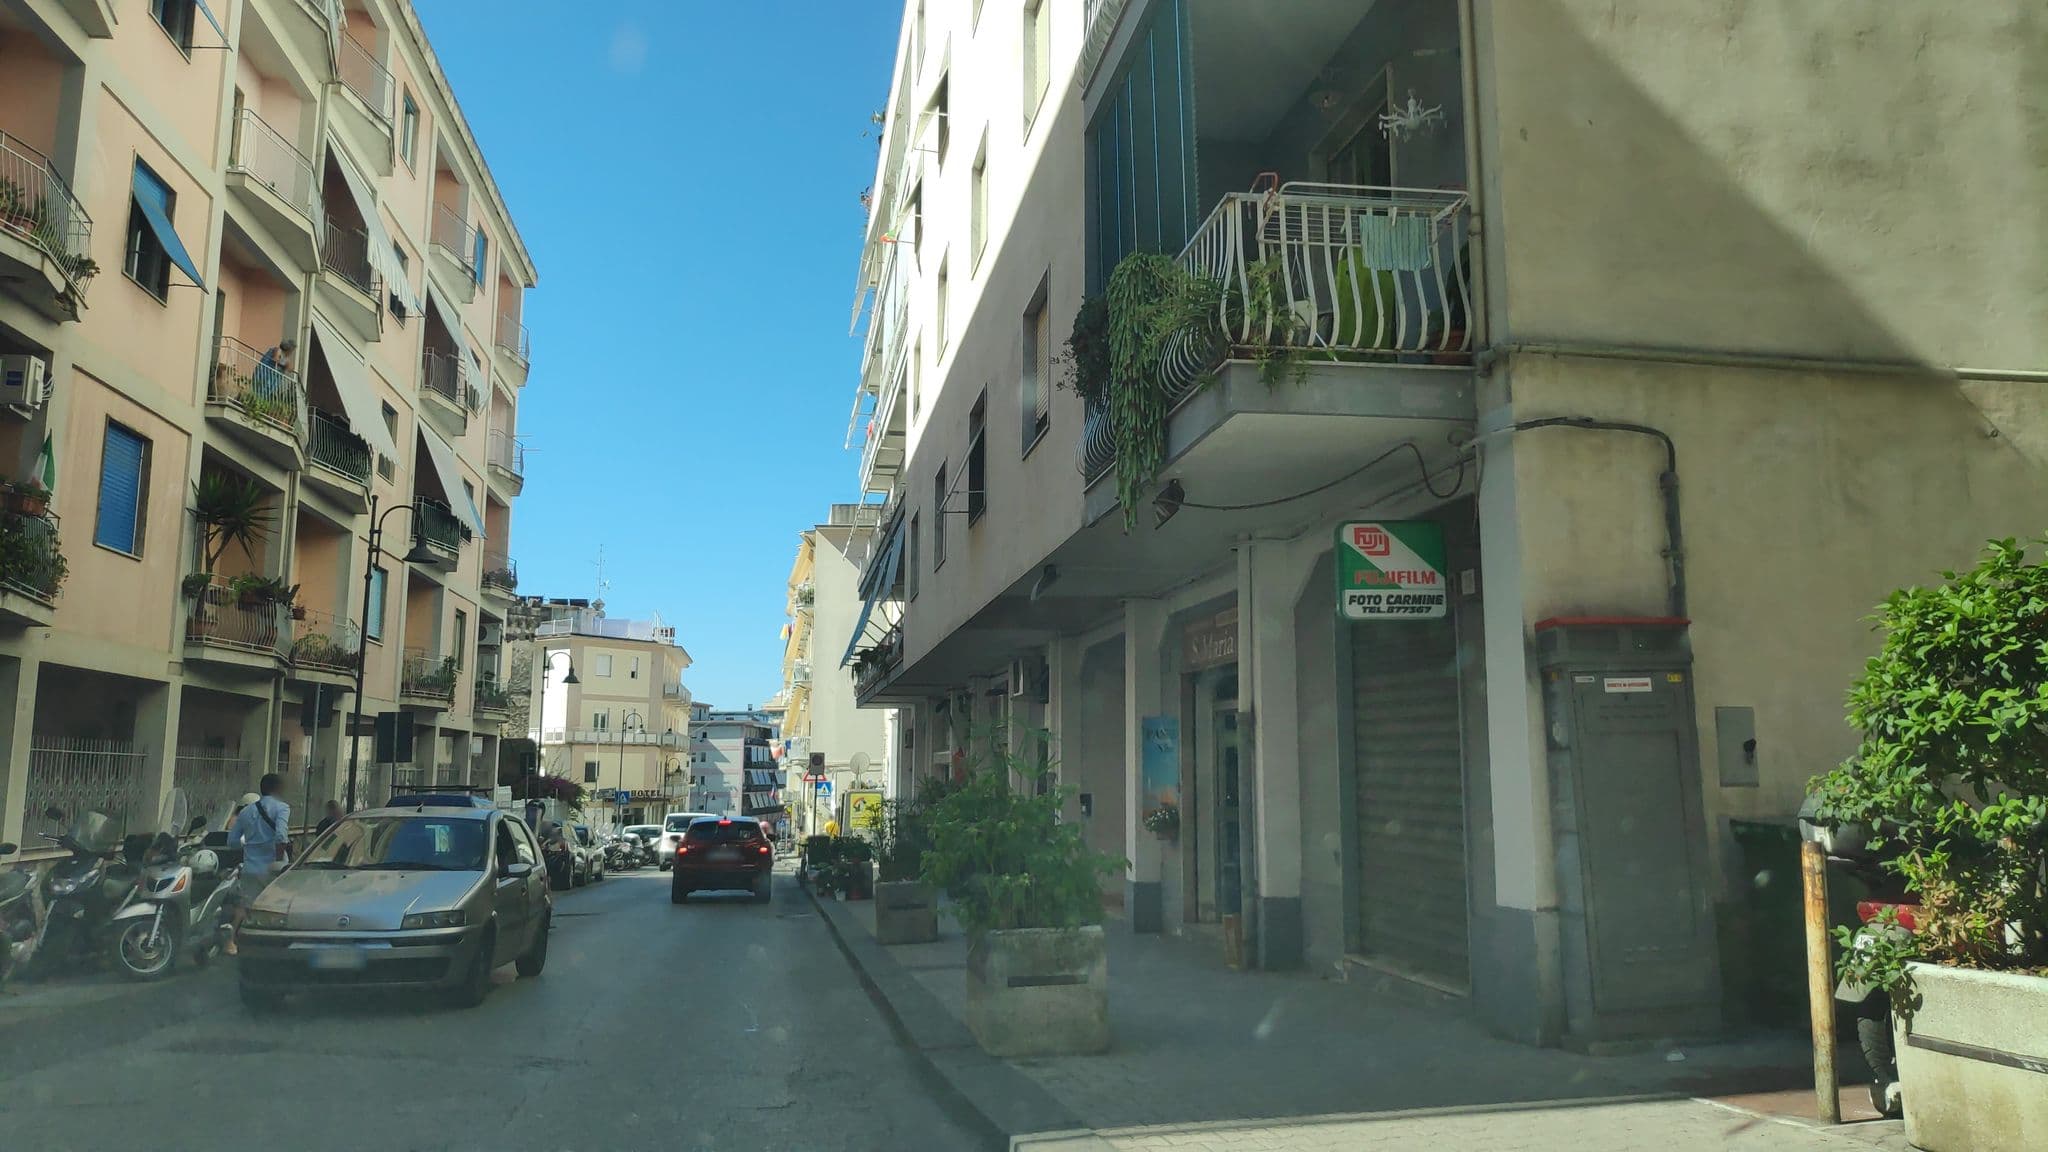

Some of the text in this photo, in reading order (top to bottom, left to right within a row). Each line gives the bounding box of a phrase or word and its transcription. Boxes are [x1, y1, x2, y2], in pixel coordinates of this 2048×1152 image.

[1354, 570, 1437, 585] FUJIFILM
[1349, 594, 1444, 606] FOTO CARMINE
[631, 789, 662, 798] HOTEL
